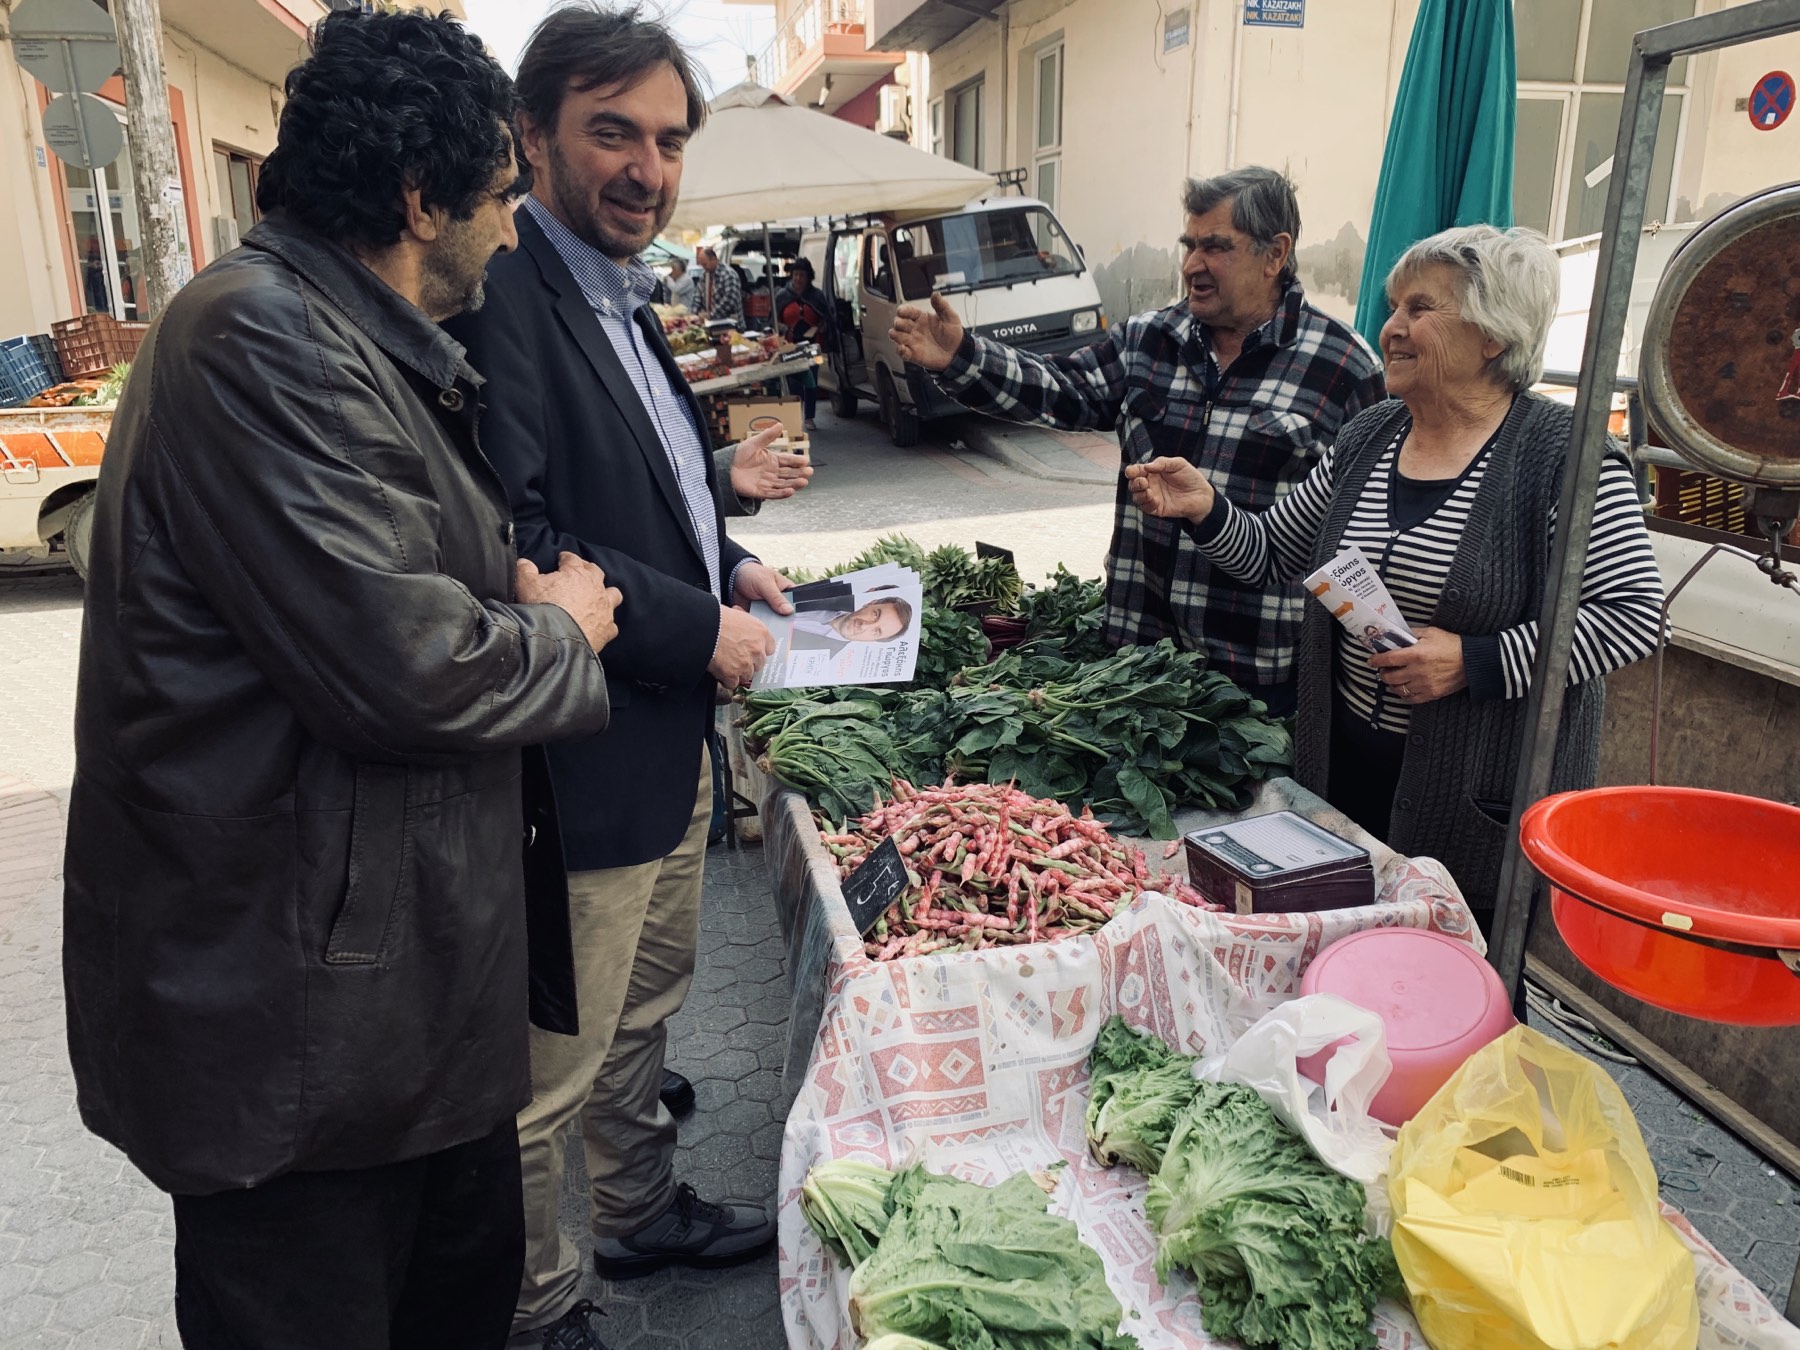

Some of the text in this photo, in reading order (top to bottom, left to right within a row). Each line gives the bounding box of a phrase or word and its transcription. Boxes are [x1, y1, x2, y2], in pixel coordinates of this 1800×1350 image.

[992, 323, 1038, 338] TOYOTA
[881, 647, 896, 678] Γιώργος
[894, 641, 909, 677] Αλεξάκης
